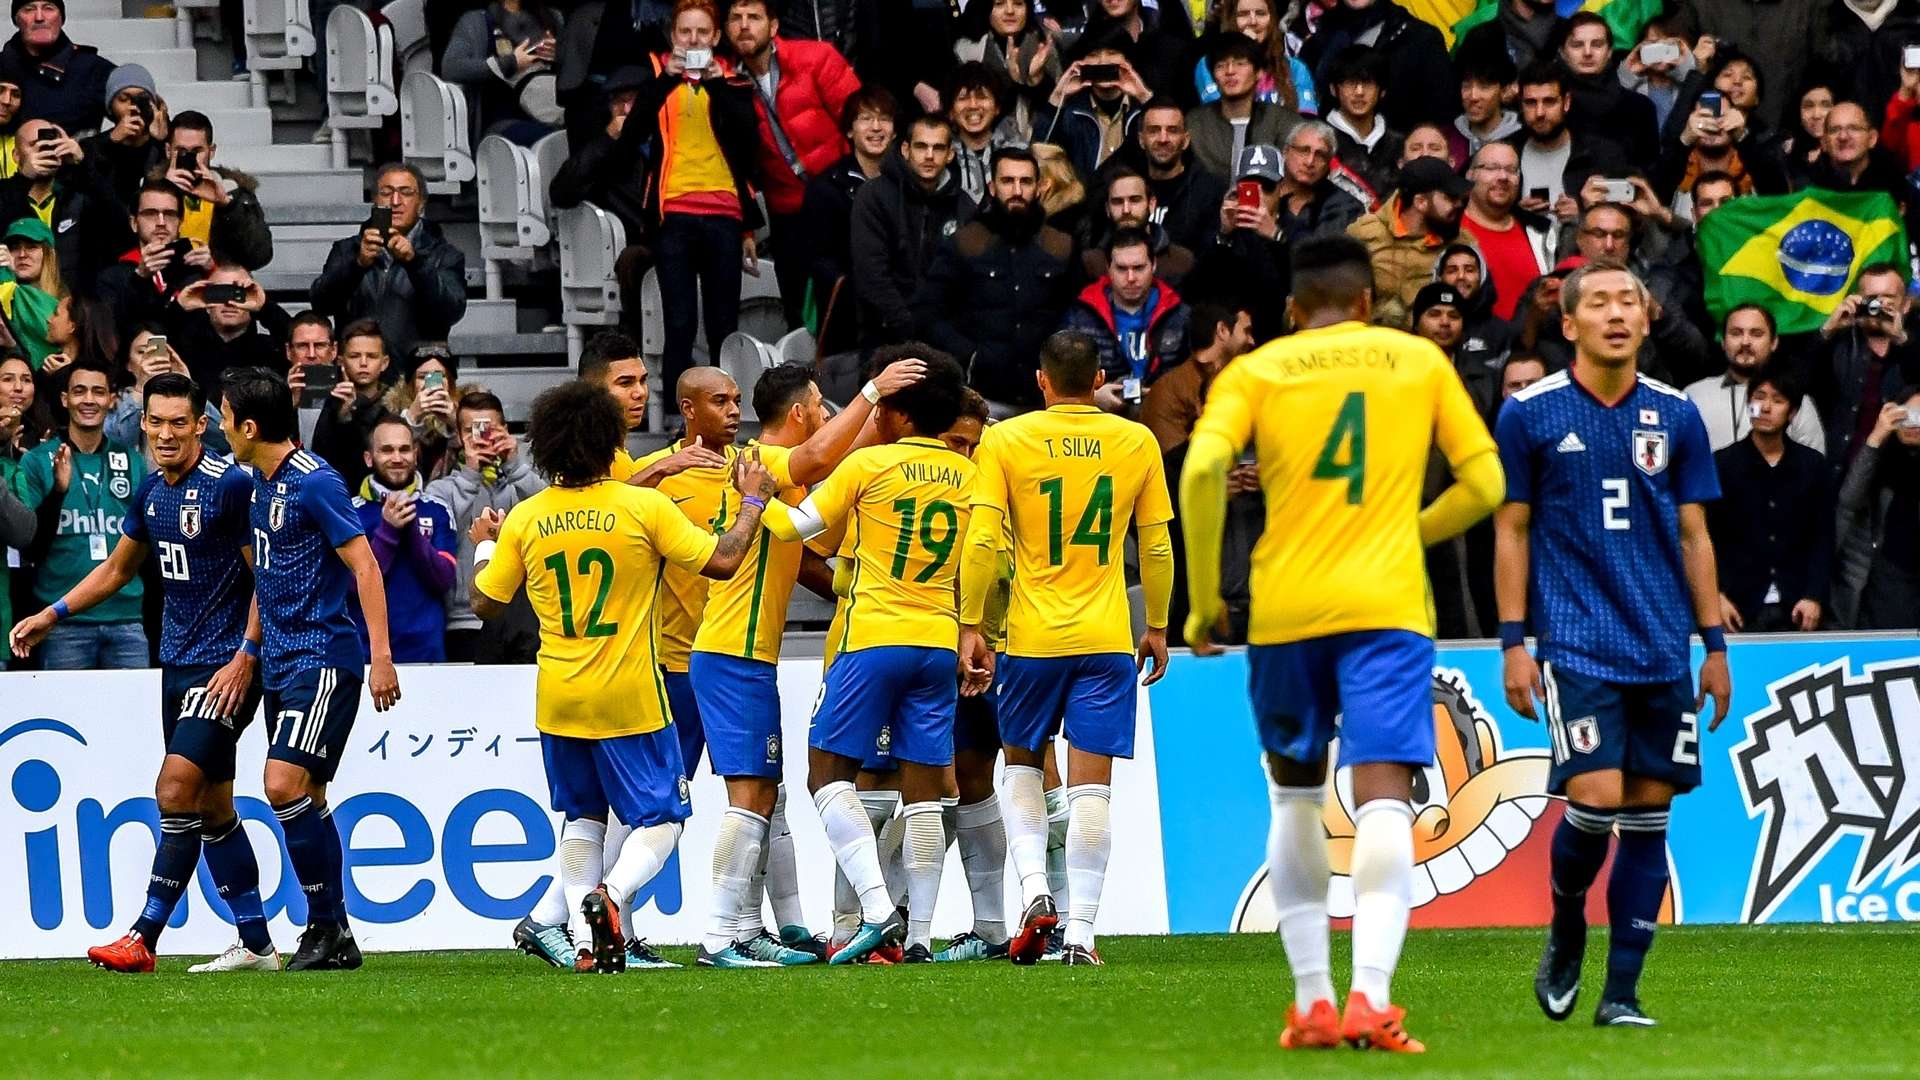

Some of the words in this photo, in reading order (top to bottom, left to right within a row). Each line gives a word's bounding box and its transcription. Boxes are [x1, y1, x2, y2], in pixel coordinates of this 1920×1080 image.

[1045, 439, 1058, 458] T.
[1062, 437, 1101, 460] SILVA
[1311, 391, 1366, 505] 4
[900, 463, 962, 490] WILLIAN
[537, 510, 616, 539] MARCELO
[1040, 475, 1113, 566] 14
[1601, 478, 1630, 530] 2
[158, 540, 190, 581] 20
[890, 497, 958, 583] 19
[544, 548, 618, 637] 12
[271, 709, 304, 748] 17
[1671, 711, 1698, 766] 2
[11, 758, 683, 931] indee
[149, 873, 179, 889] APAN
[1818, 883, 1889, 922] Ice
